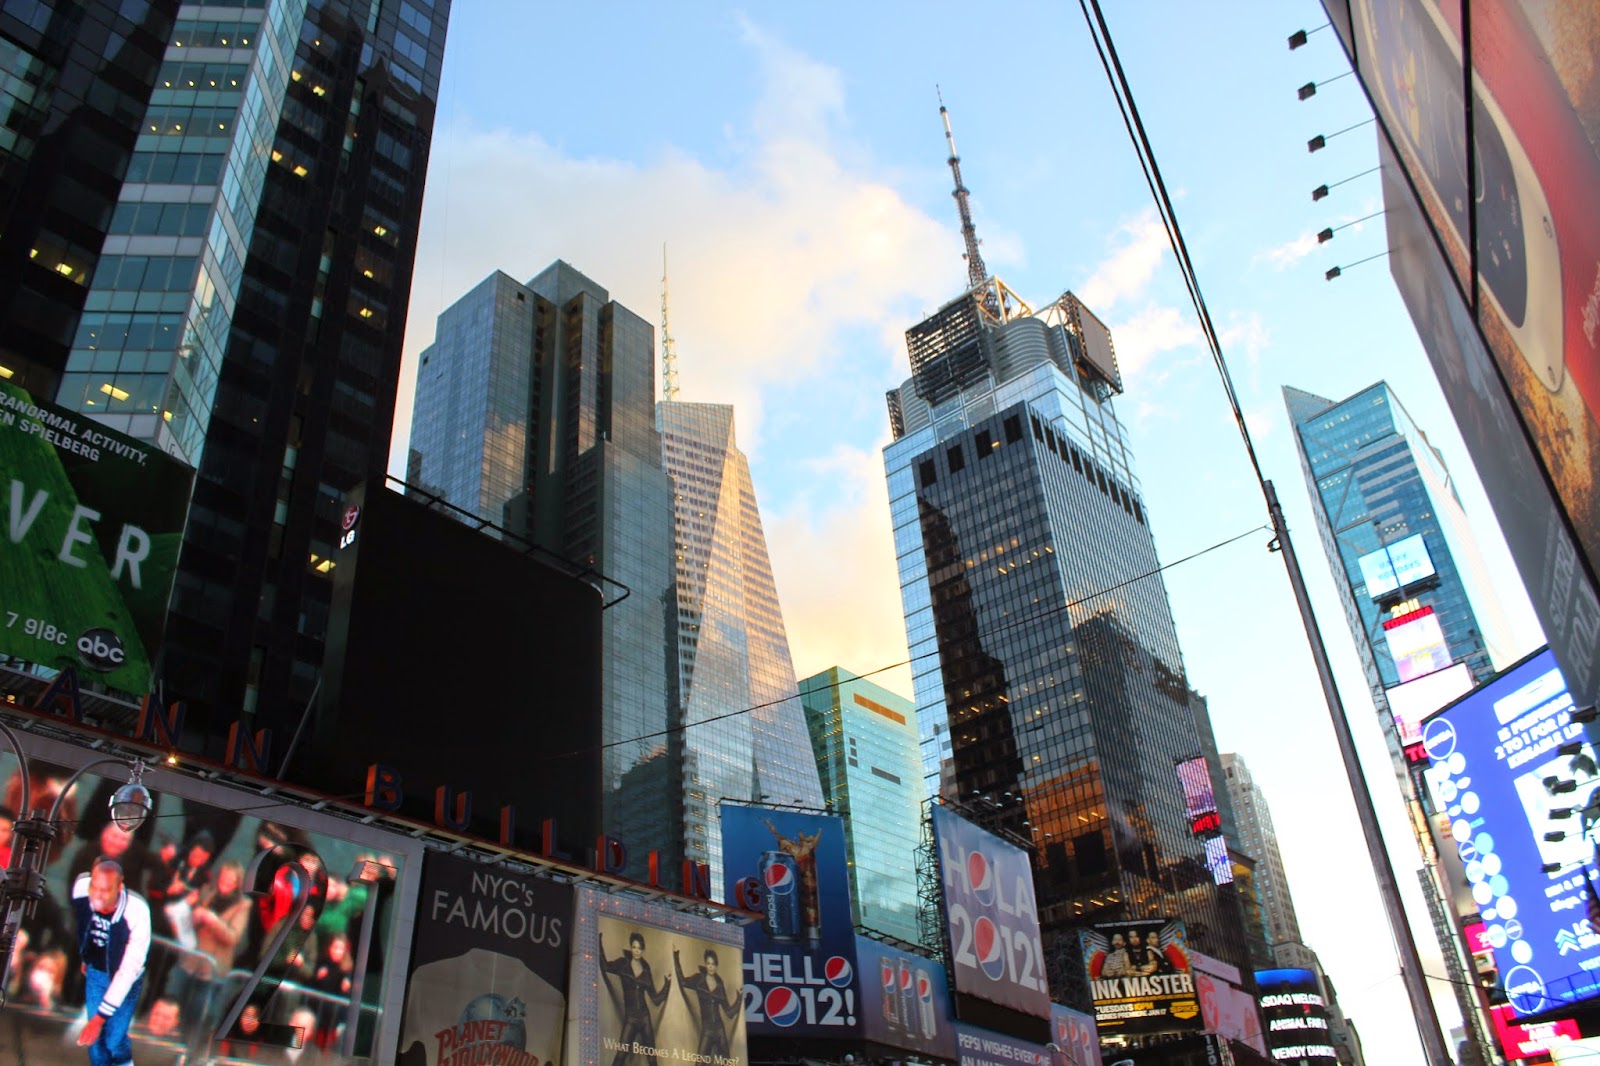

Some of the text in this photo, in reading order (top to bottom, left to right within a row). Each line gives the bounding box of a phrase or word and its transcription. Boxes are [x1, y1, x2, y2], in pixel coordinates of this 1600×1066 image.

[20, 418, 101, 462] SPIELBERG
[81, 429, 149, 467] ACTIVITY,
[9, 479, 152, 590] VER
[340, 529, 356, 549] LG
[1384, 605, 1433, 630] TOSHIBA
[1391, 598, 1421, 619] 2011
[77, 635, 125, 663] abc
[364, 762, 765, 913] BUILDING
[471, 870, 534, 907] NYC's
[431, 889, 562, 948] FAMOUS
[766, 893, 778, 929] pepsi
[1090, 979, 1123, 1001] INK
[1121, 973, 1195, 998] MASTER
[1094, 1003, 1135, 1015] TUESDAYS
[434, 1019, 511, 1057] PLANET
[957, 1032, 982, 1052] PEPSI
[981, 1038, 1014, 1060] WISHES
